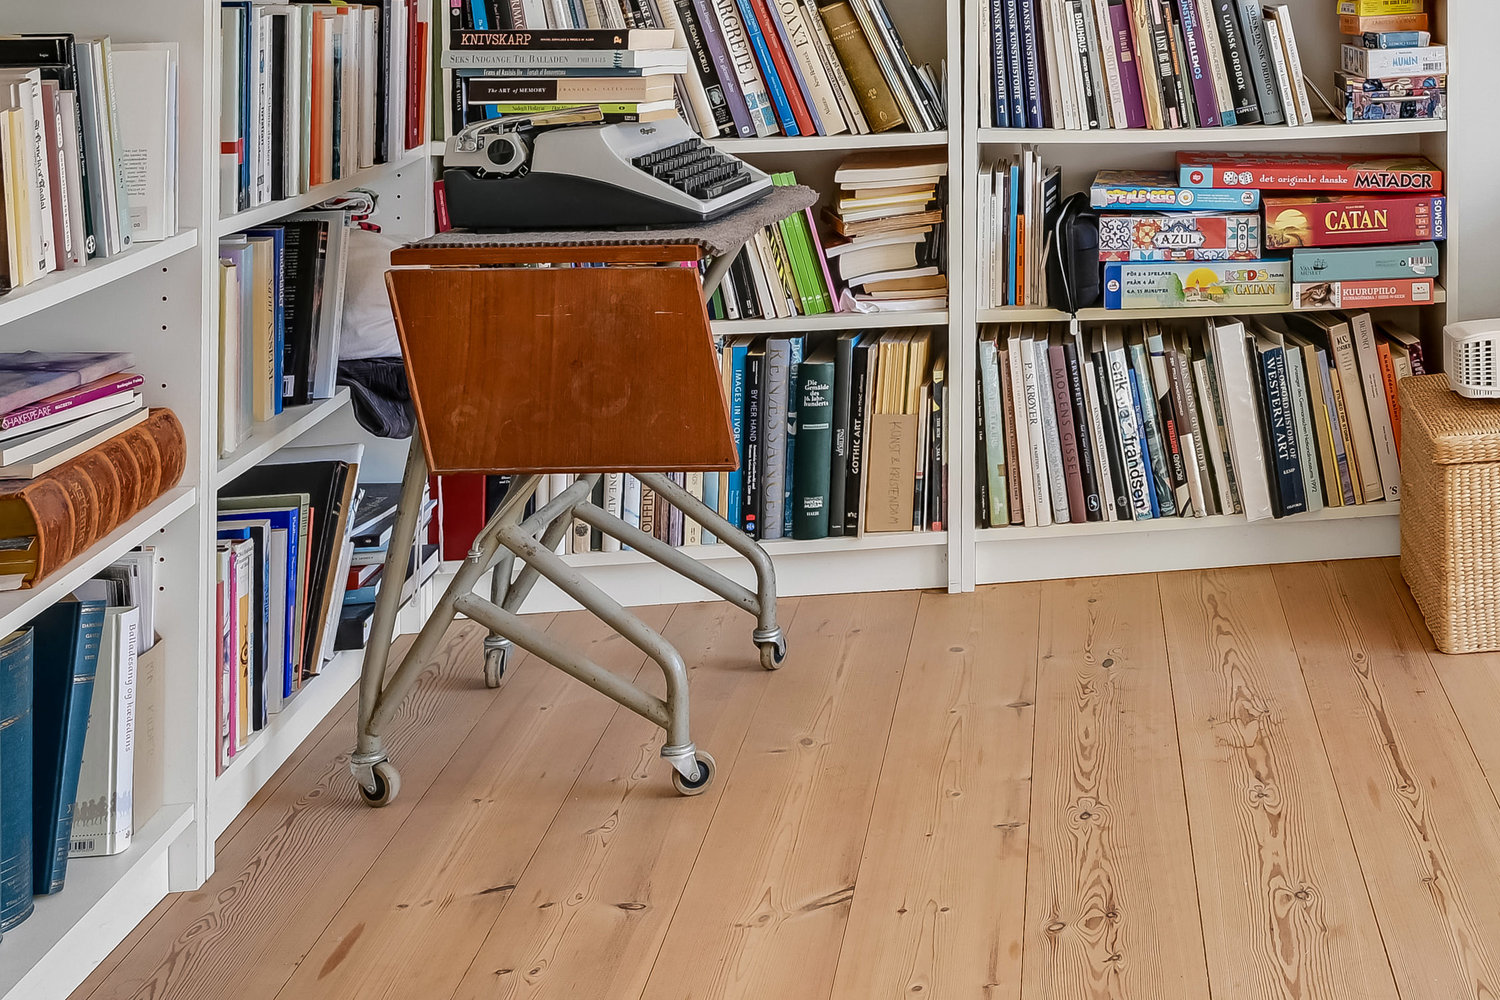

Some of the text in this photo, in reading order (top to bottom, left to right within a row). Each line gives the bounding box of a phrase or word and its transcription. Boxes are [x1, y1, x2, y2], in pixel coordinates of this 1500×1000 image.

[992, 1, 1001, 36] DANSK
[1007, 1, 1016, 37] DANSK
[1022, 2, 1032, 37] DANSK
[1074, 13, 1088, 54] BAUHAUS
[461, 34, 531, 45] KNIVSKARP
[1222, 14, 1245, 91] LATINSK ORDBOK
[1248, 4, 1274, 96] NORSK-DANSK ORDBOG
[994, 38, 1005, 100] KUNSTHISTORIE
[1009, 39, 1021, 101] KUNSTHISTORIE
[1024, 39, 1037, 101] KUNSTHISTORIE
[1392, 56, 1418, 67] MUMIN
[1259, 171, 1433, 189] det originale danske MATADOR
[1324, 209, 1388, 231] CATAN
[1434, 199, 1442, 238] KOSMOS
[1161, 235, 1196, 244] AZUL
[1224, 270, 1268, 281] KIDS
[1233, 283, 1276, 296] CATAN
[1342, 286, 1397, 296] KUURUPIILO
[734, 369, 742, 403] IMAGES
[1070, 360, 1083, 407] KRYDSFELT
[1026, 384, 1039, 426] KRØYER
[1054, 368, 1078, 478] MOGENS GISSEL
[1266, 357, 1289, 460] WESTERN ART
[1293, 365, 1303, 388] Anzeiger
[1298, 398, 1308, 434] Germanischen
[1303, 434, 1315, 479] Nationalmuseums
[749, 419, 757, 441] HAND
[765, 349, 786, 530] RENÆSSANCEN
[1111, 362, 1147, 510] erik frandsen
[851, 440, 860, 474] GOTHIC
[124, 623, 137, 686] Balladesang
[124, 702, 136, 752] kædedans
